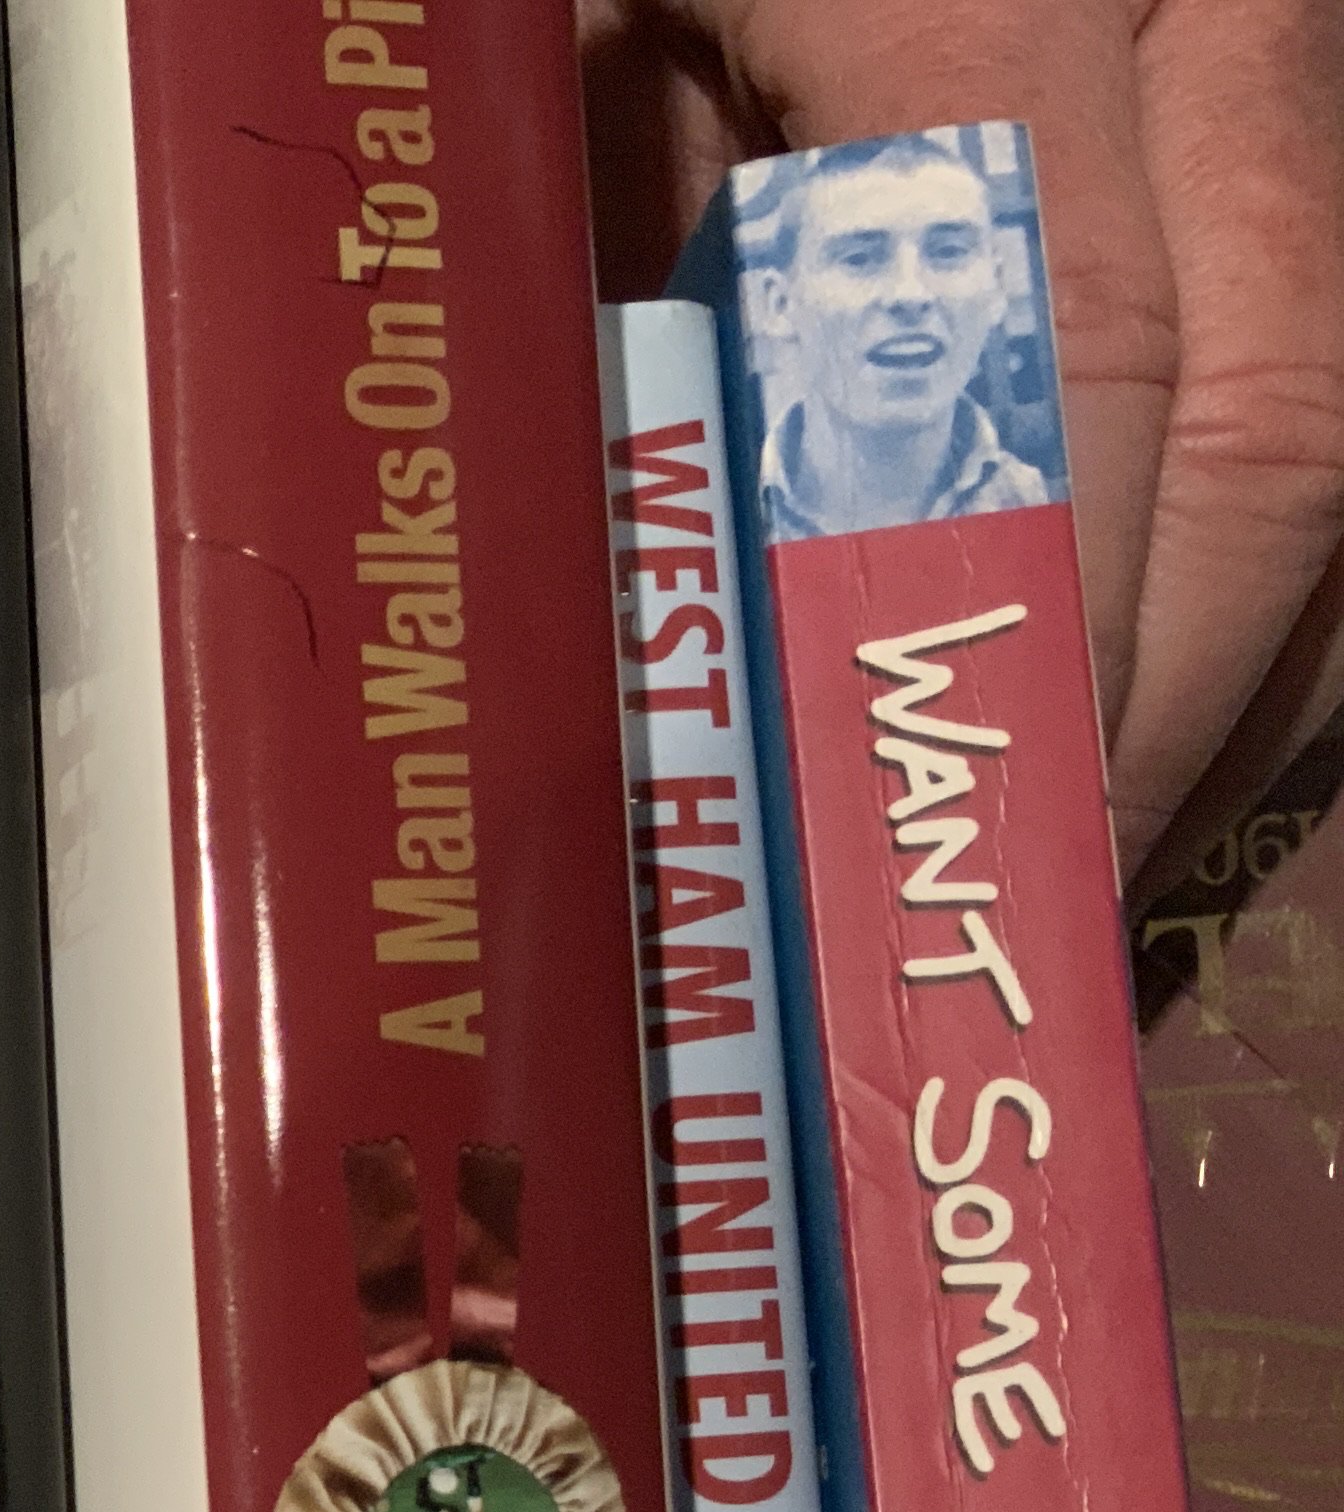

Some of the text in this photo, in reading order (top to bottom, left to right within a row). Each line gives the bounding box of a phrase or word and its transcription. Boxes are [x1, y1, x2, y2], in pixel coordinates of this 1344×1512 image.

[357, 104, 434, 165] a
[339, 182, 443, 283] To
[344, 301, 453, 430] On
[355, 447, 469, 741] Walks
[371, 753, 480, 964] Man
[855, 603, 1034, 1026] WANT
[378, 988, 485, 1057] A
[607, 420, 794, 1506] WEST HAM UNITED
